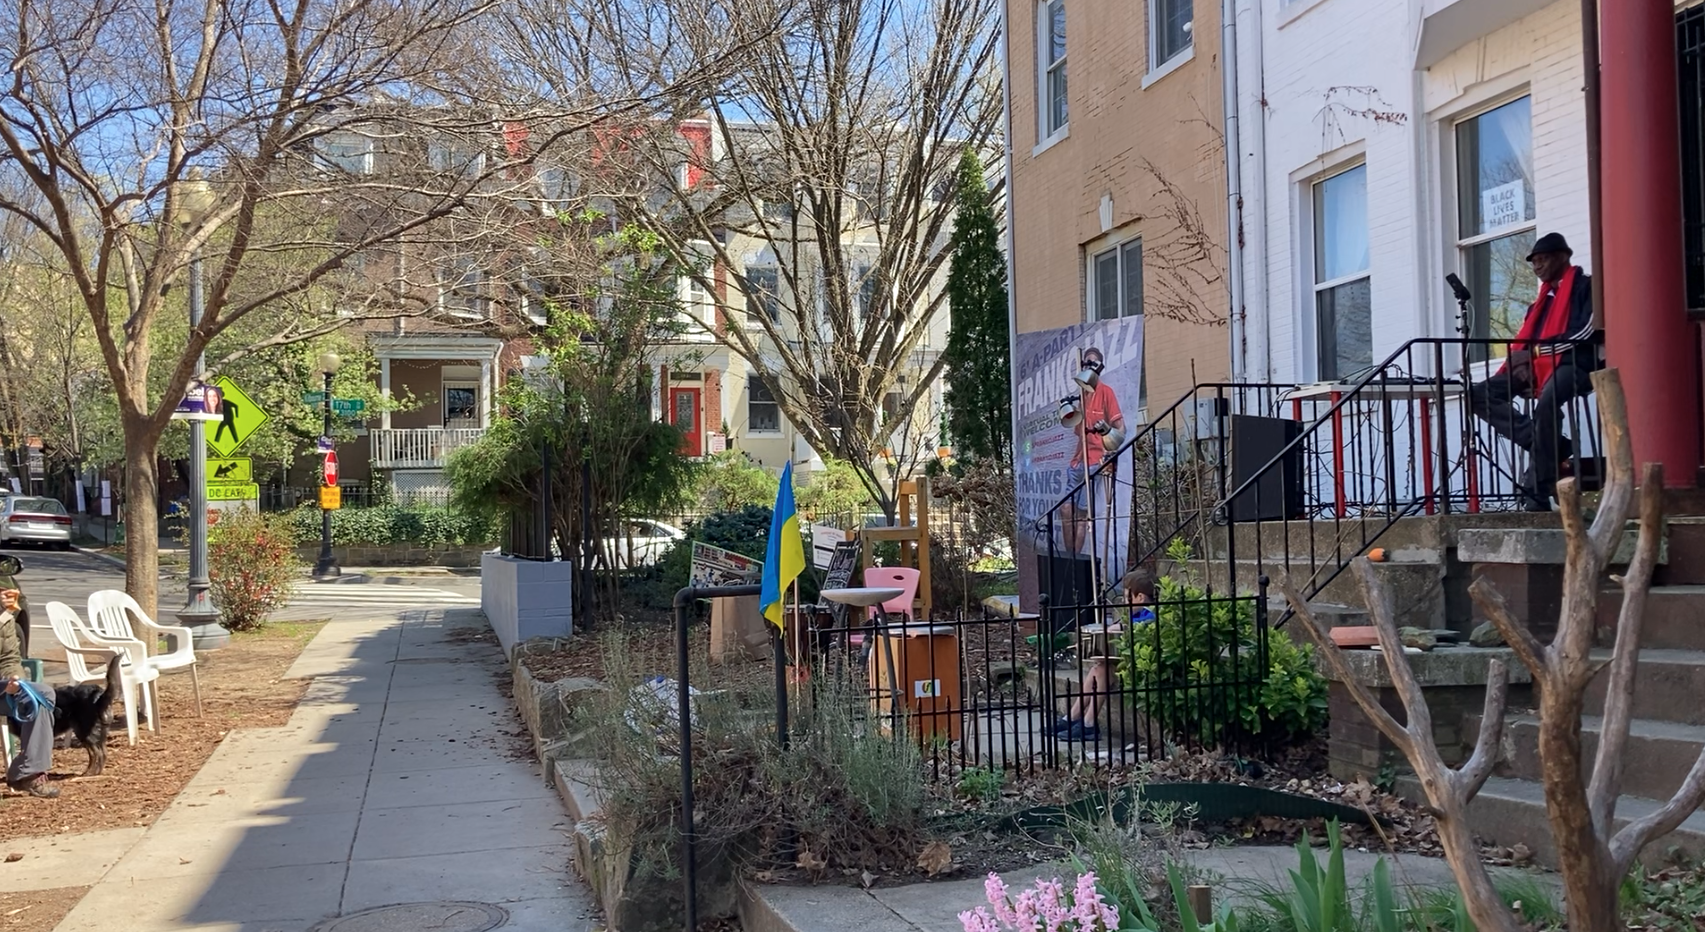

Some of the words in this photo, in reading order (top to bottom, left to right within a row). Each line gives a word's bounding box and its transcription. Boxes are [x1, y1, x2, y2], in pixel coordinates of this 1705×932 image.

[1490, 188, 1515, 205] BLACK
[1493, 200, 1514, 216] LIVES
[1489, 211, 1520, 229] MATTER
[335, 400, 351, 410] 17th
[1018, 469, 1062, 495] THANKS
